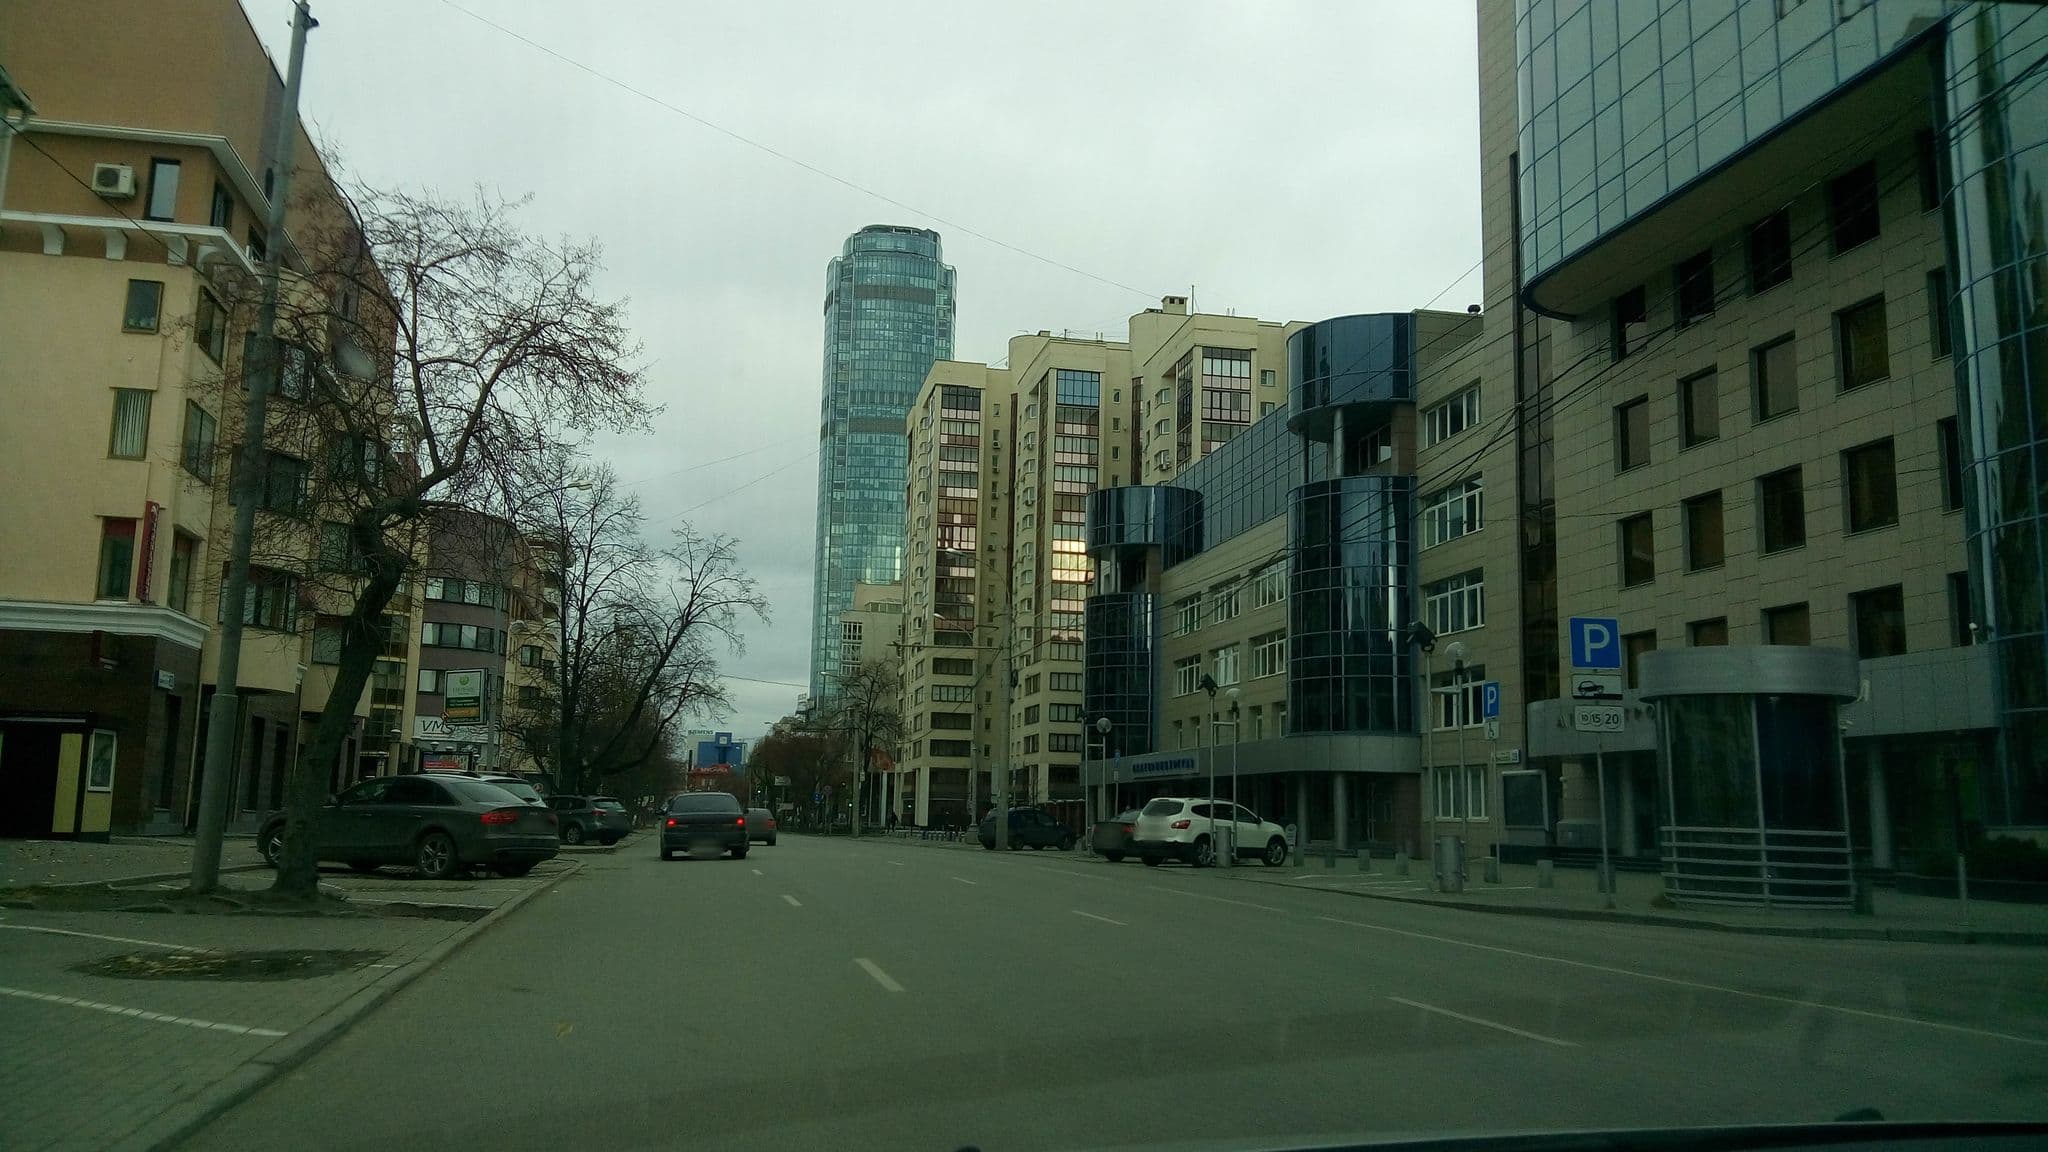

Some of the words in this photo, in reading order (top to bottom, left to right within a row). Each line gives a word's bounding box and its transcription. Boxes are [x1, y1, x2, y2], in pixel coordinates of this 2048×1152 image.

[1583, 623, 1610, 663] P
[1487, 686, 1497, 714] P
[1592, 714, 1601, 723] 15
[1605, 713, 1619, 724] 20
